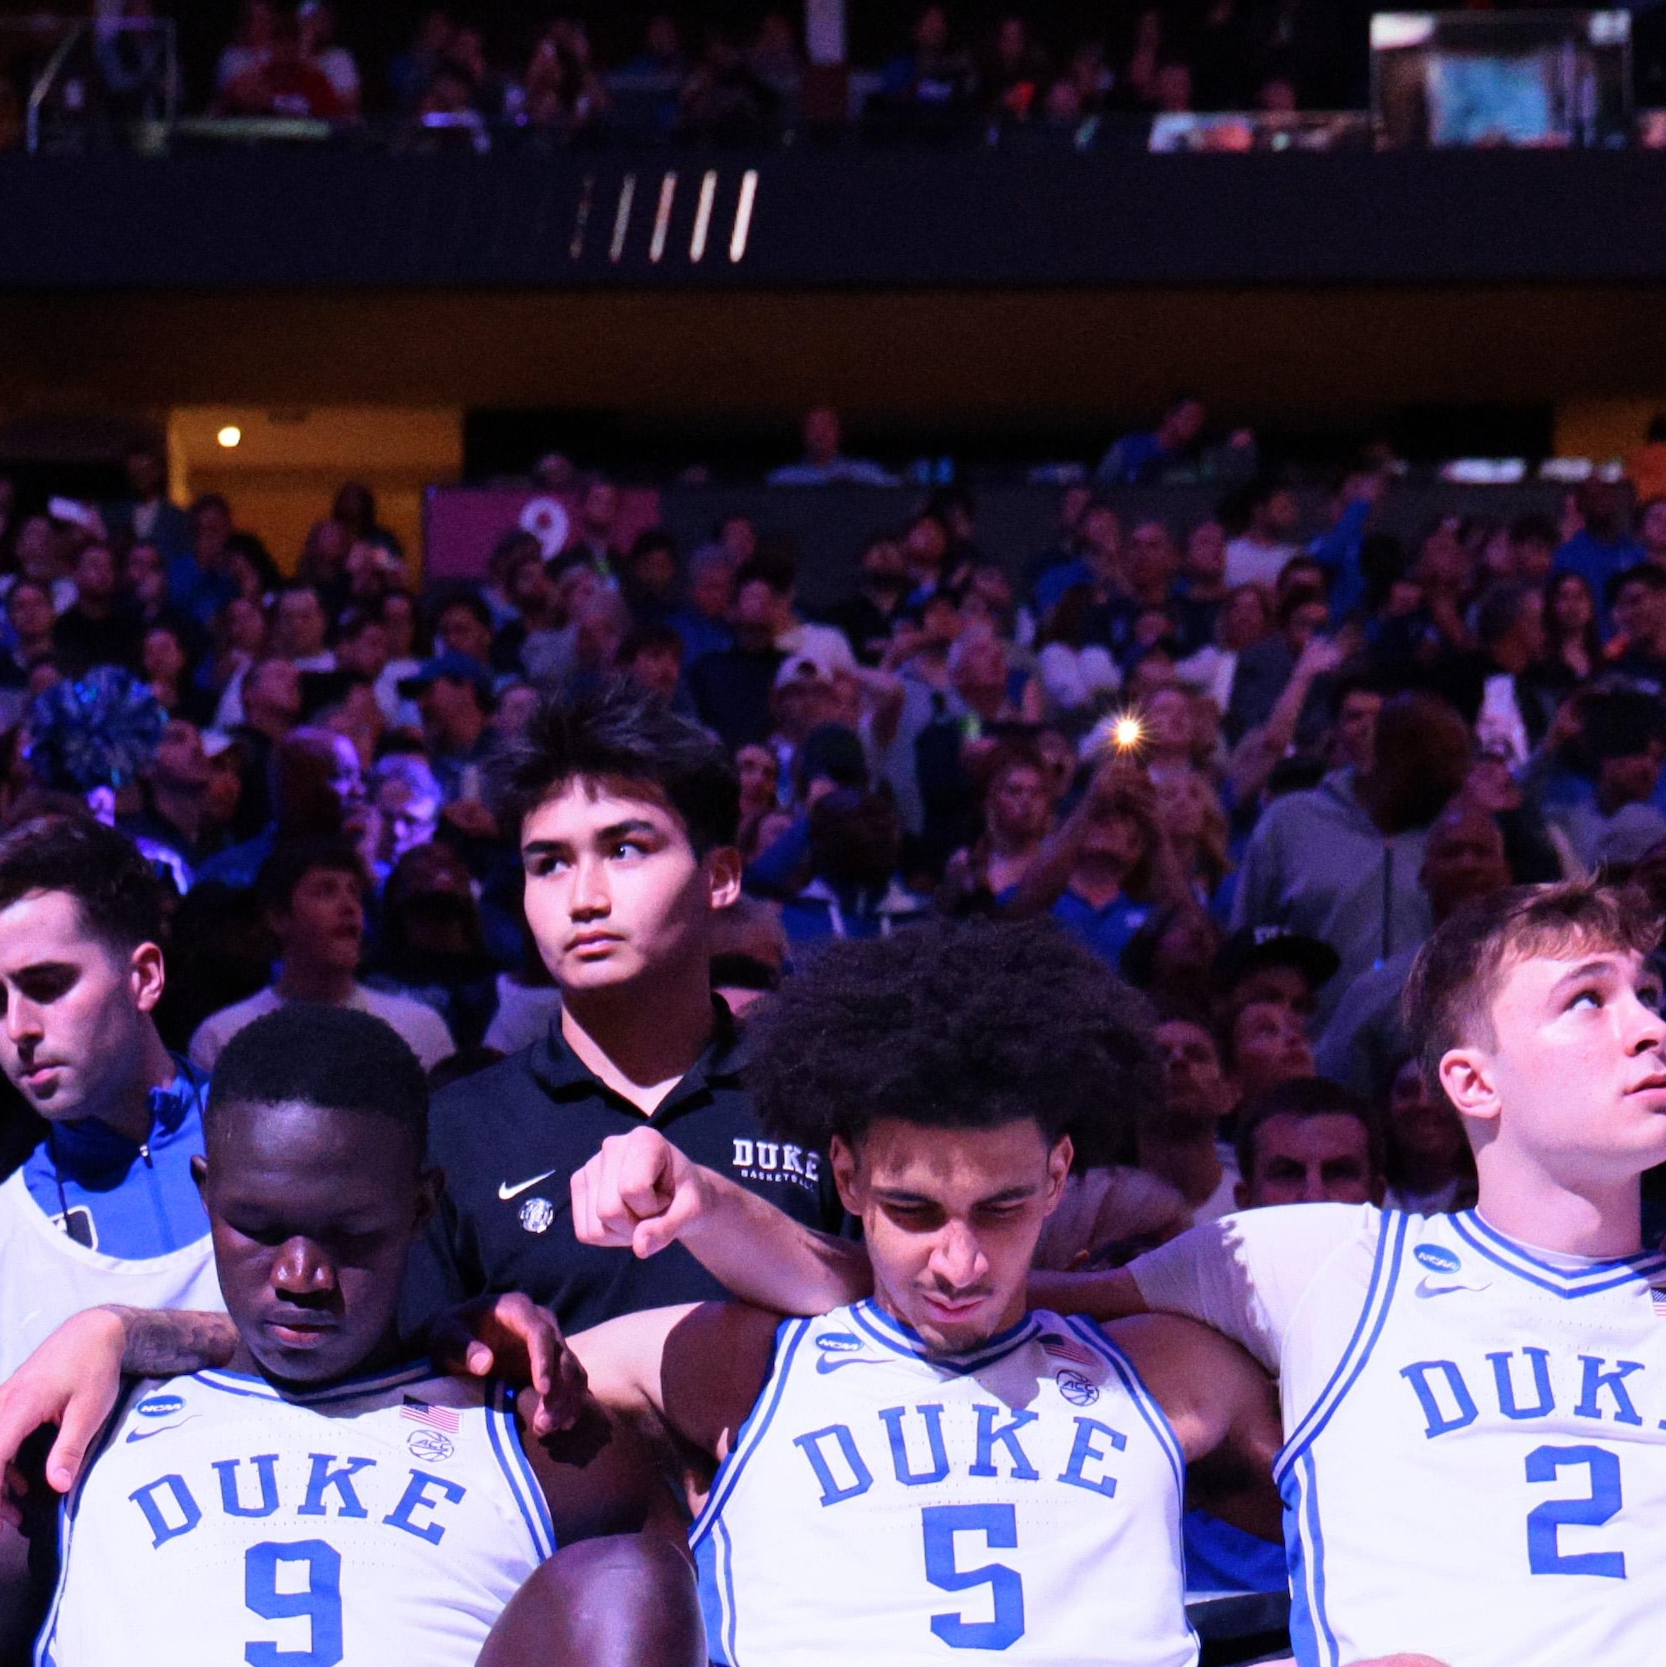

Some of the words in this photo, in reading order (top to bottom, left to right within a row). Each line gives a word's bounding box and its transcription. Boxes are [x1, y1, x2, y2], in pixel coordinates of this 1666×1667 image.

[732, 1138, 820, 1183] DUKE
[817, 1337, 859, 1350] NCAA
[139, 1401, 182, 1414] NCAA
[1062, 1380, 1095, 1395] ACC
[416, 1438, 451, 1452] ACC
[792, 1403, 1128, 1508] DUKE
[128, 1452, 467, 1551] DUKE
[1524, 1444, 1627, 1580] 2
[921, 1503, 1025, 1651] 5
